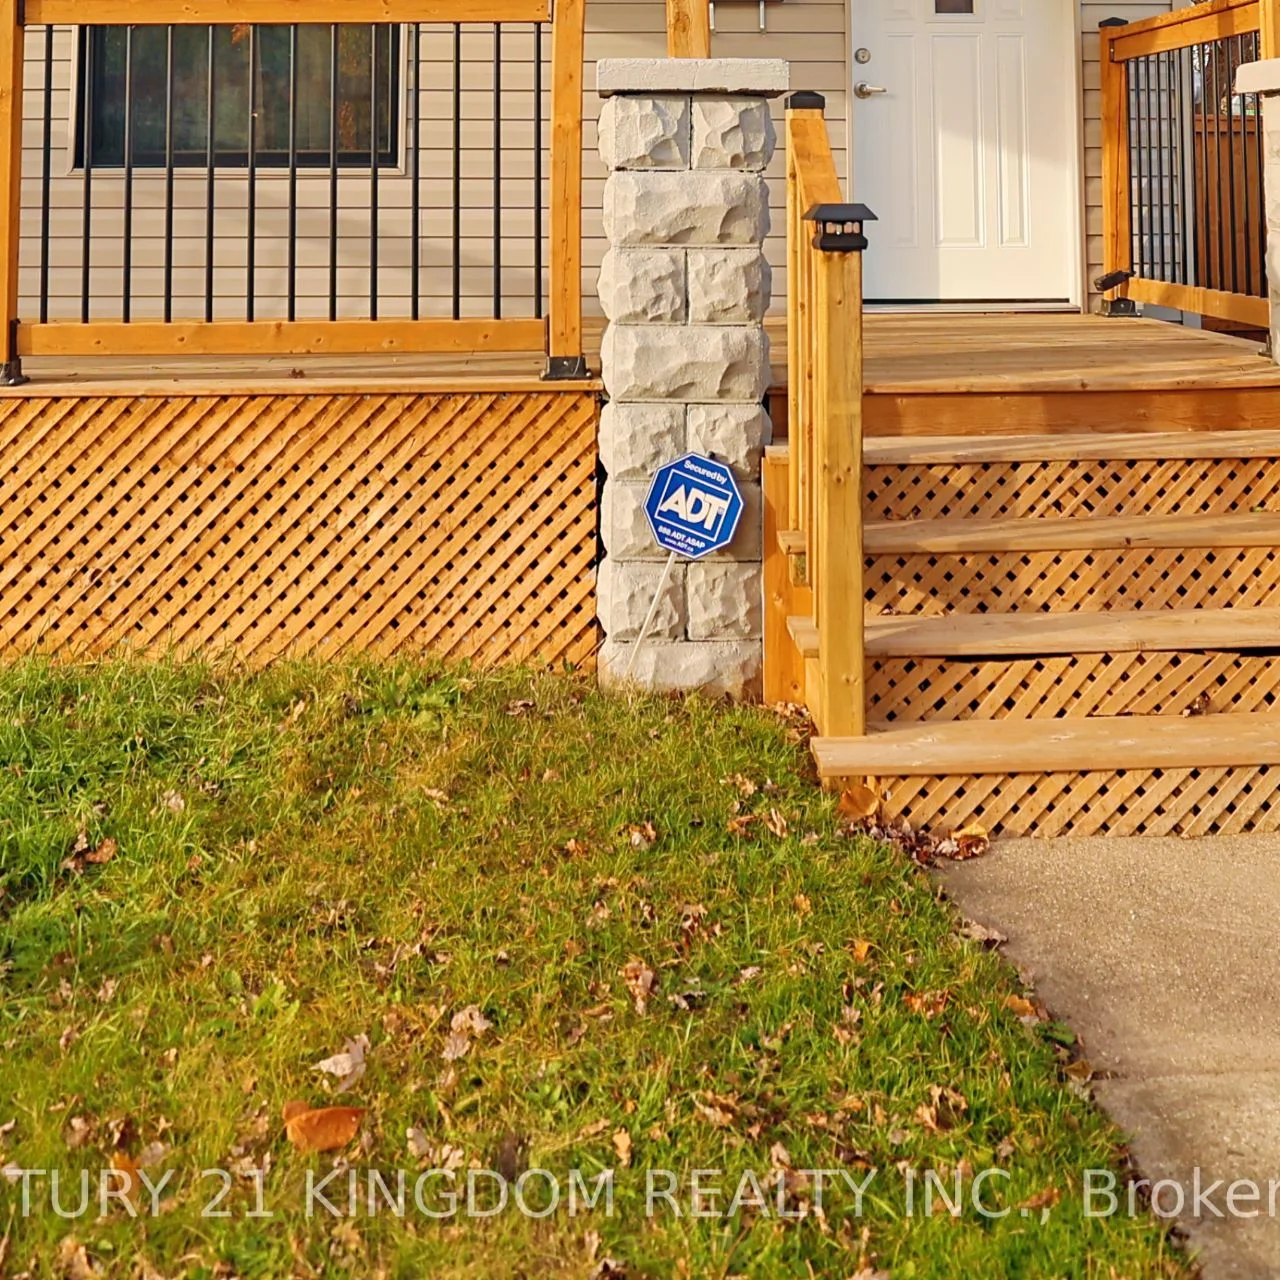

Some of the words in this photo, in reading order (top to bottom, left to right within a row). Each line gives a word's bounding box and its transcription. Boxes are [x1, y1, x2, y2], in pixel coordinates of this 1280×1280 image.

[684, 460, 717, 479] Secured
[716, 472, 727, 485] by
[660, 484, 728, 530] ADT
[670, 531, 686, 542] ADT
[685, 536, 706, 548] ASAP
